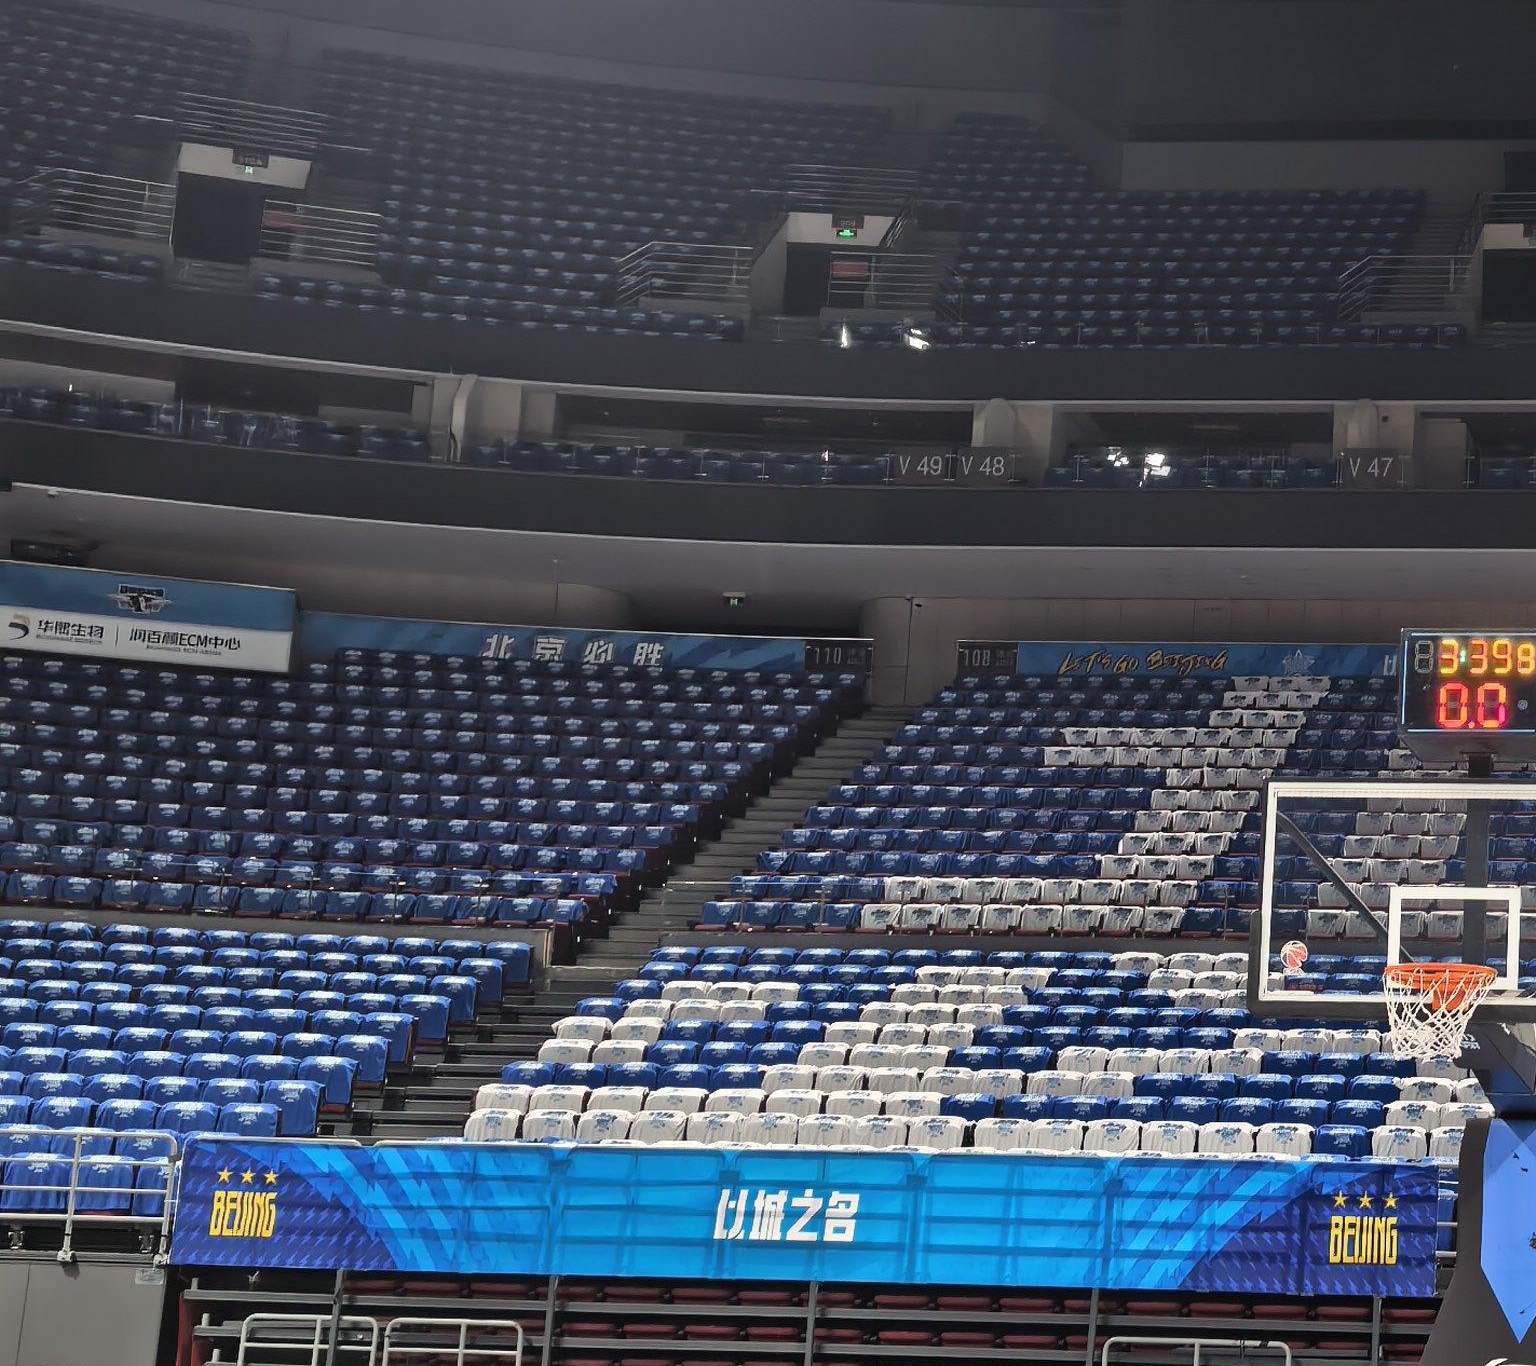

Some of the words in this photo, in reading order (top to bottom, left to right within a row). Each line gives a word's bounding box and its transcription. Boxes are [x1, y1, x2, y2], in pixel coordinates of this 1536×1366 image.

[900, 455, 914, 476] V
[917, 455, 943, 476] 49
[961, 455, 975, 476] V
[979, 455, 1005, 476] 48
[1348, 456, 1361, 477] V
[1367, 456, 1393, 477] 47
[480, 633, 665, 668] 北京必胜
[1113, 654, 1139, 674] GO
[209, 1189, 278, 1238] BEIJING
[713, 1188, 860, 1242] 以城之名
[1329, 1215, 1398, 1265] BEIJING
